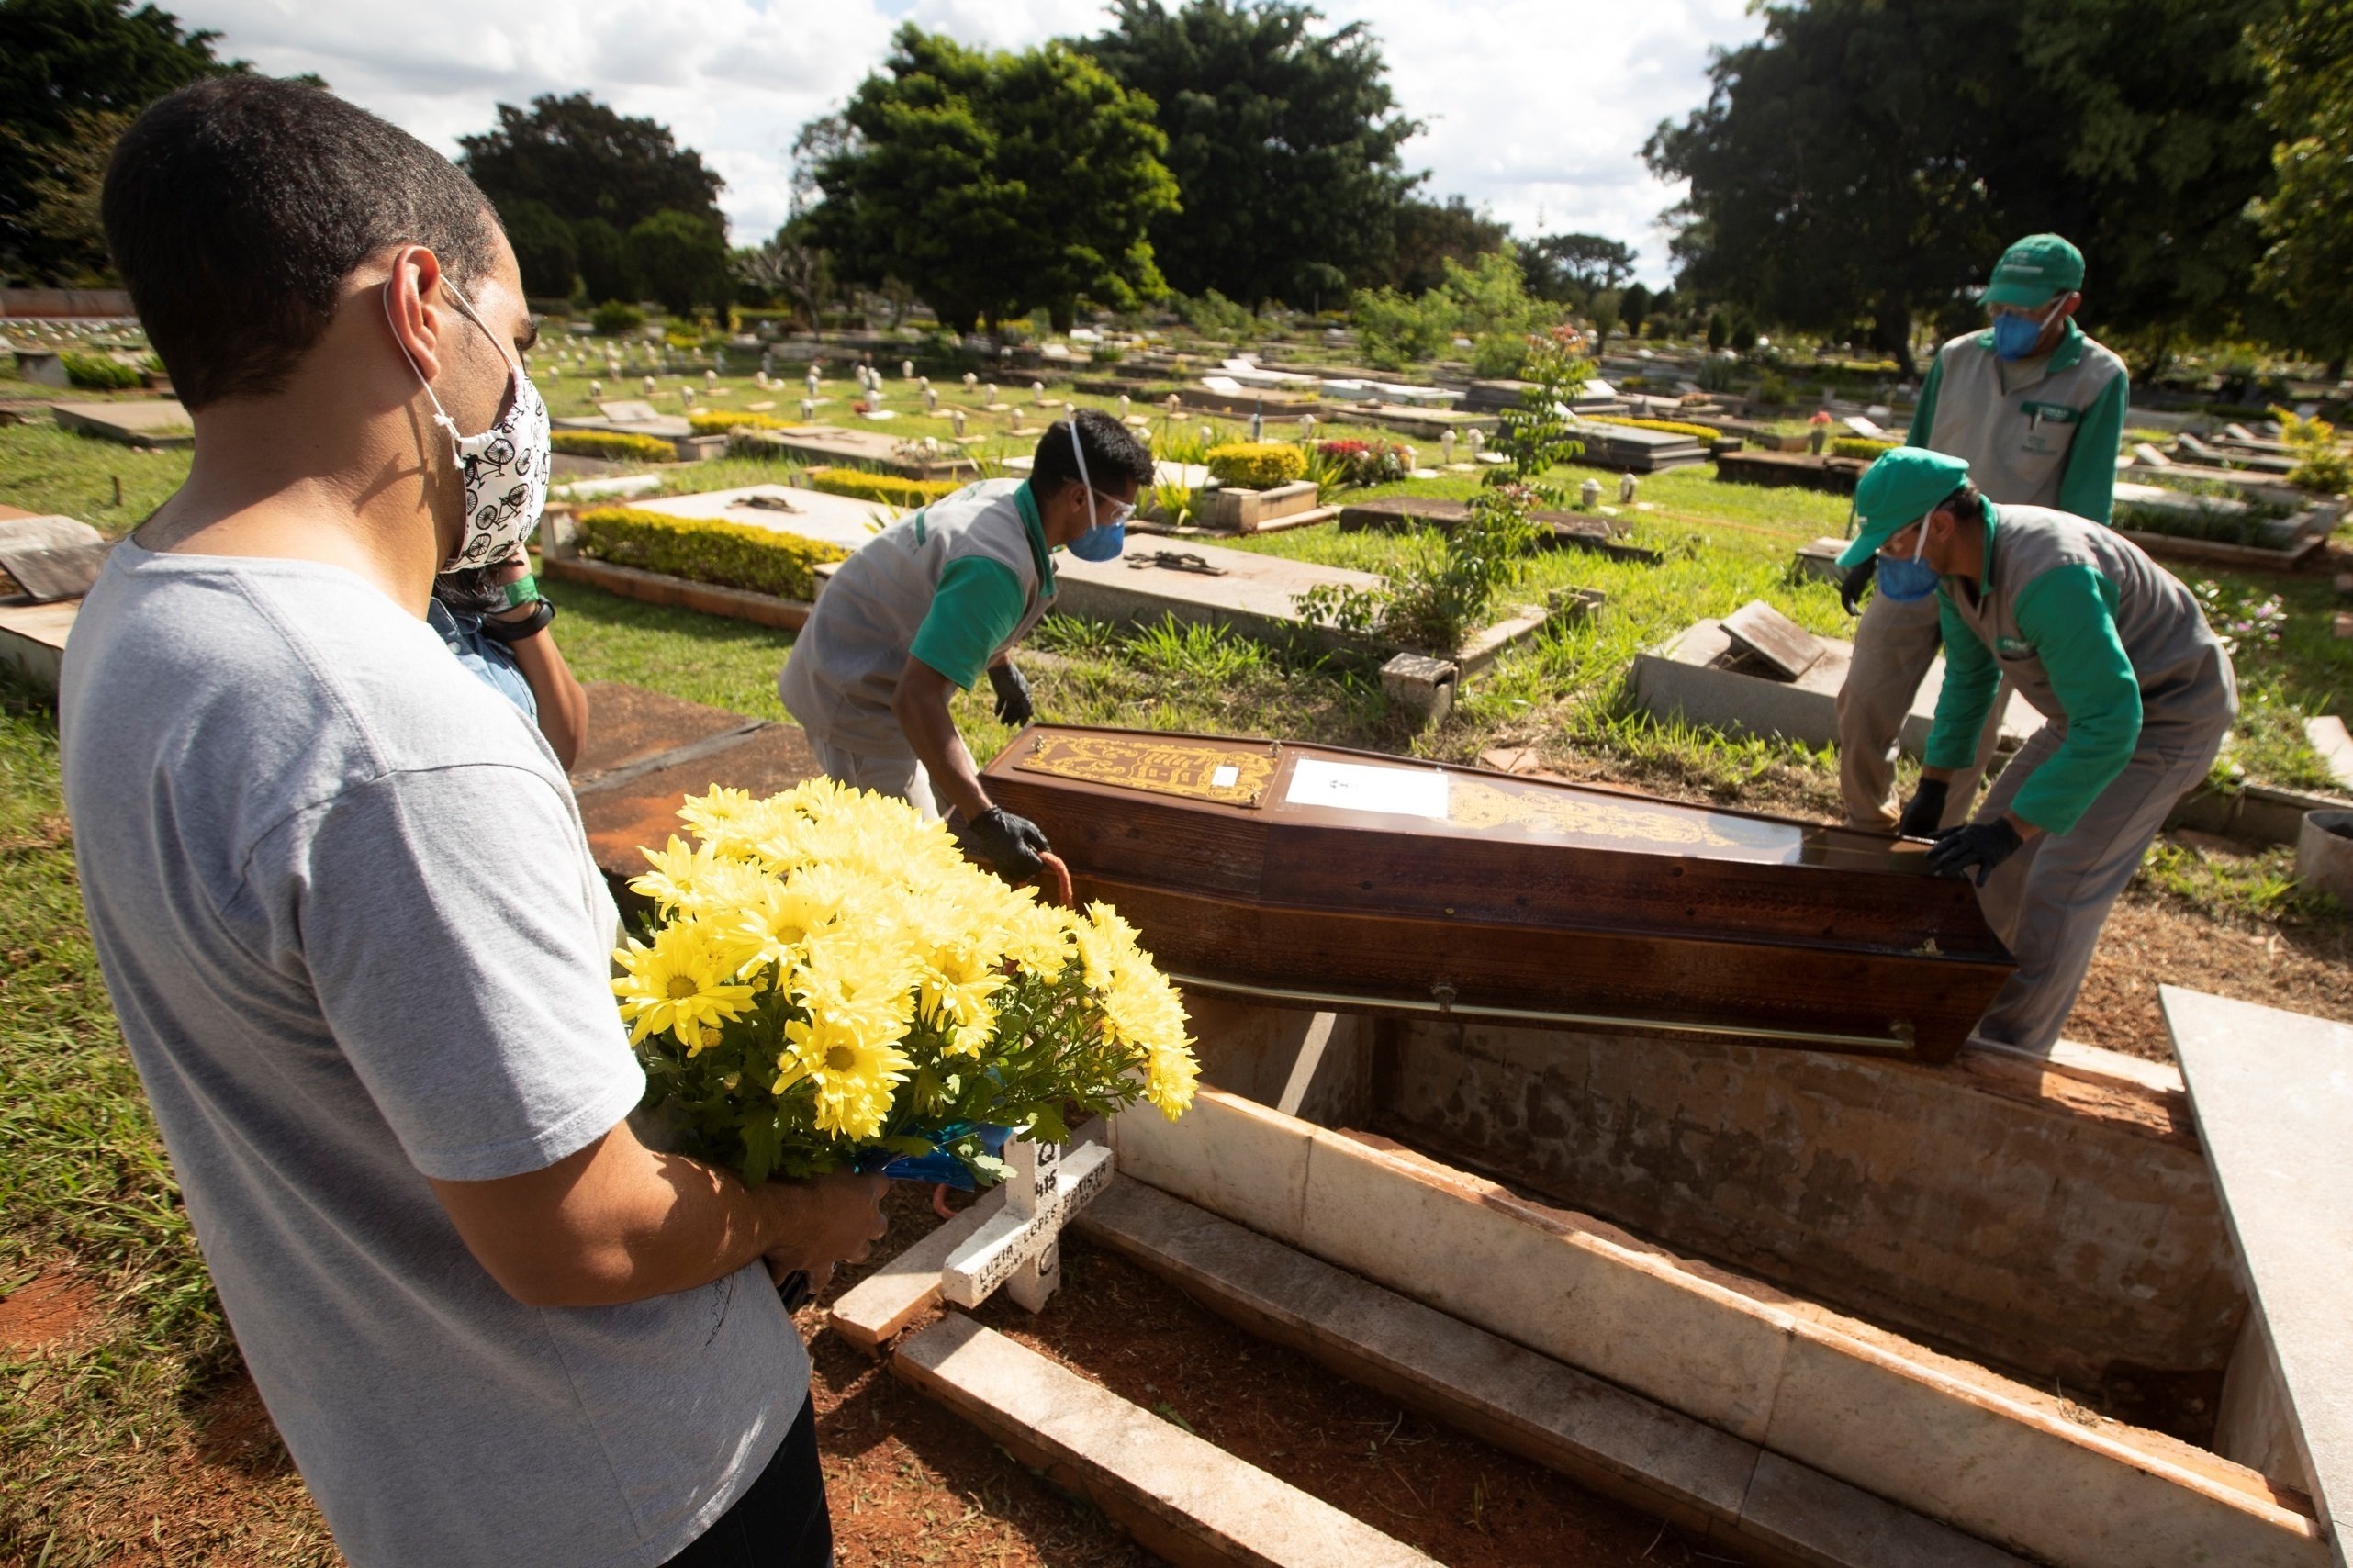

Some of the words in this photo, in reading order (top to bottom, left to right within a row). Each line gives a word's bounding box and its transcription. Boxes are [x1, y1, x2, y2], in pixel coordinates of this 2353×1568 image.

[1038, 1140, 1056, 1167] Q
[1035, 1169, 1058, 1198] 415
[980, 1244, 1014, 1285] LUZIA
[1023, 1203, 1058, 1244] LOPES
[1038, 1242, 1054, 1277] C
